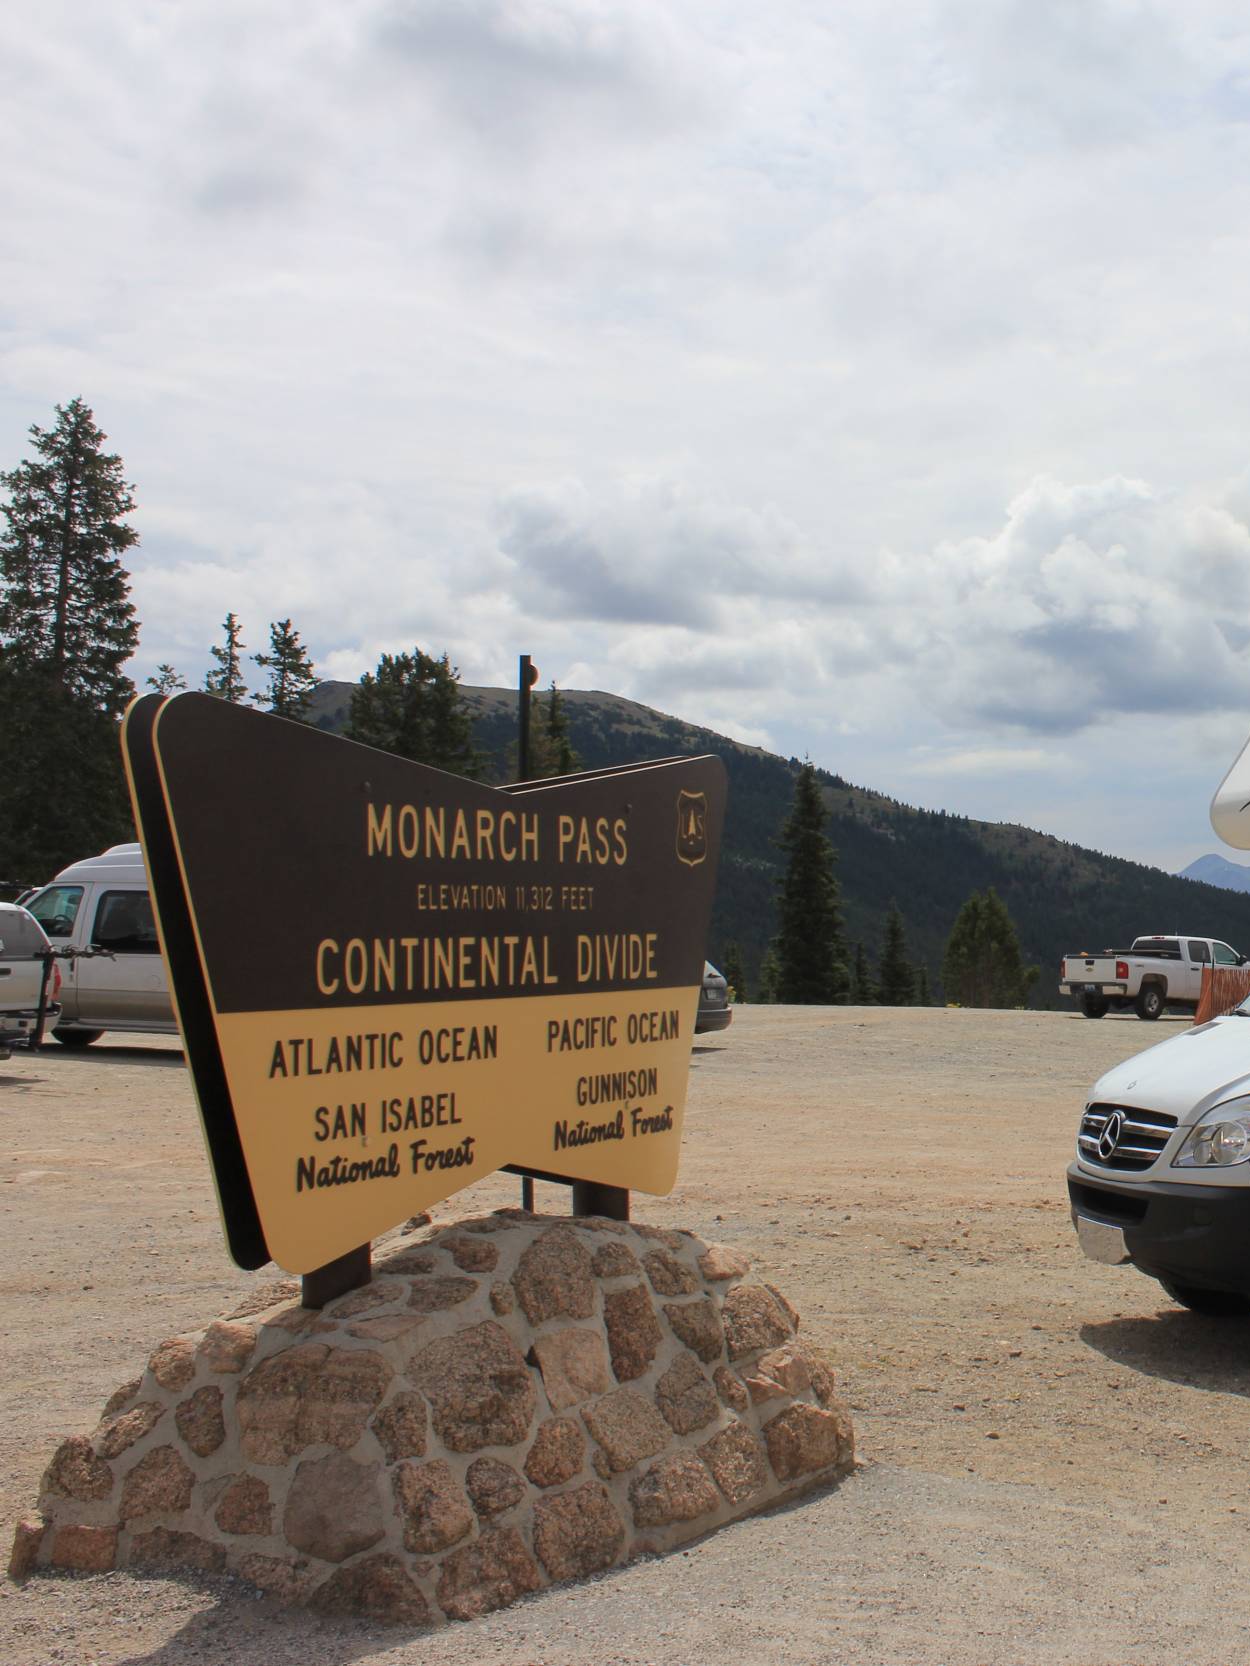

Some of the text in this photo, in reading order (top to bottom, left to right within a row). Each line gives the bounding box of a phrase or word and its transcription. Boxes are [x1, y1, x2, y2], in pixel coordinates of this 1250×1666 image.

[367, 803, 628, 865] MONARCH PASS
[417, 884, 594, 911] ELEVATION 11,312 FEET
[316, 933, 658, 995] CONTINENTAL DIVIDE
[269, 1025, 498, 1079] ATLANTIC OCEAN
[547, 1010, 679, 1053] PACIFIC OCEAN
[577, 1067, 657, 1106] GUNNISON
[314, 1092, 462, 1142] SAN ISABEL
[554, 1105, 673, 1151] National Forest
[296, 1136, 476, 1192] National Forest
